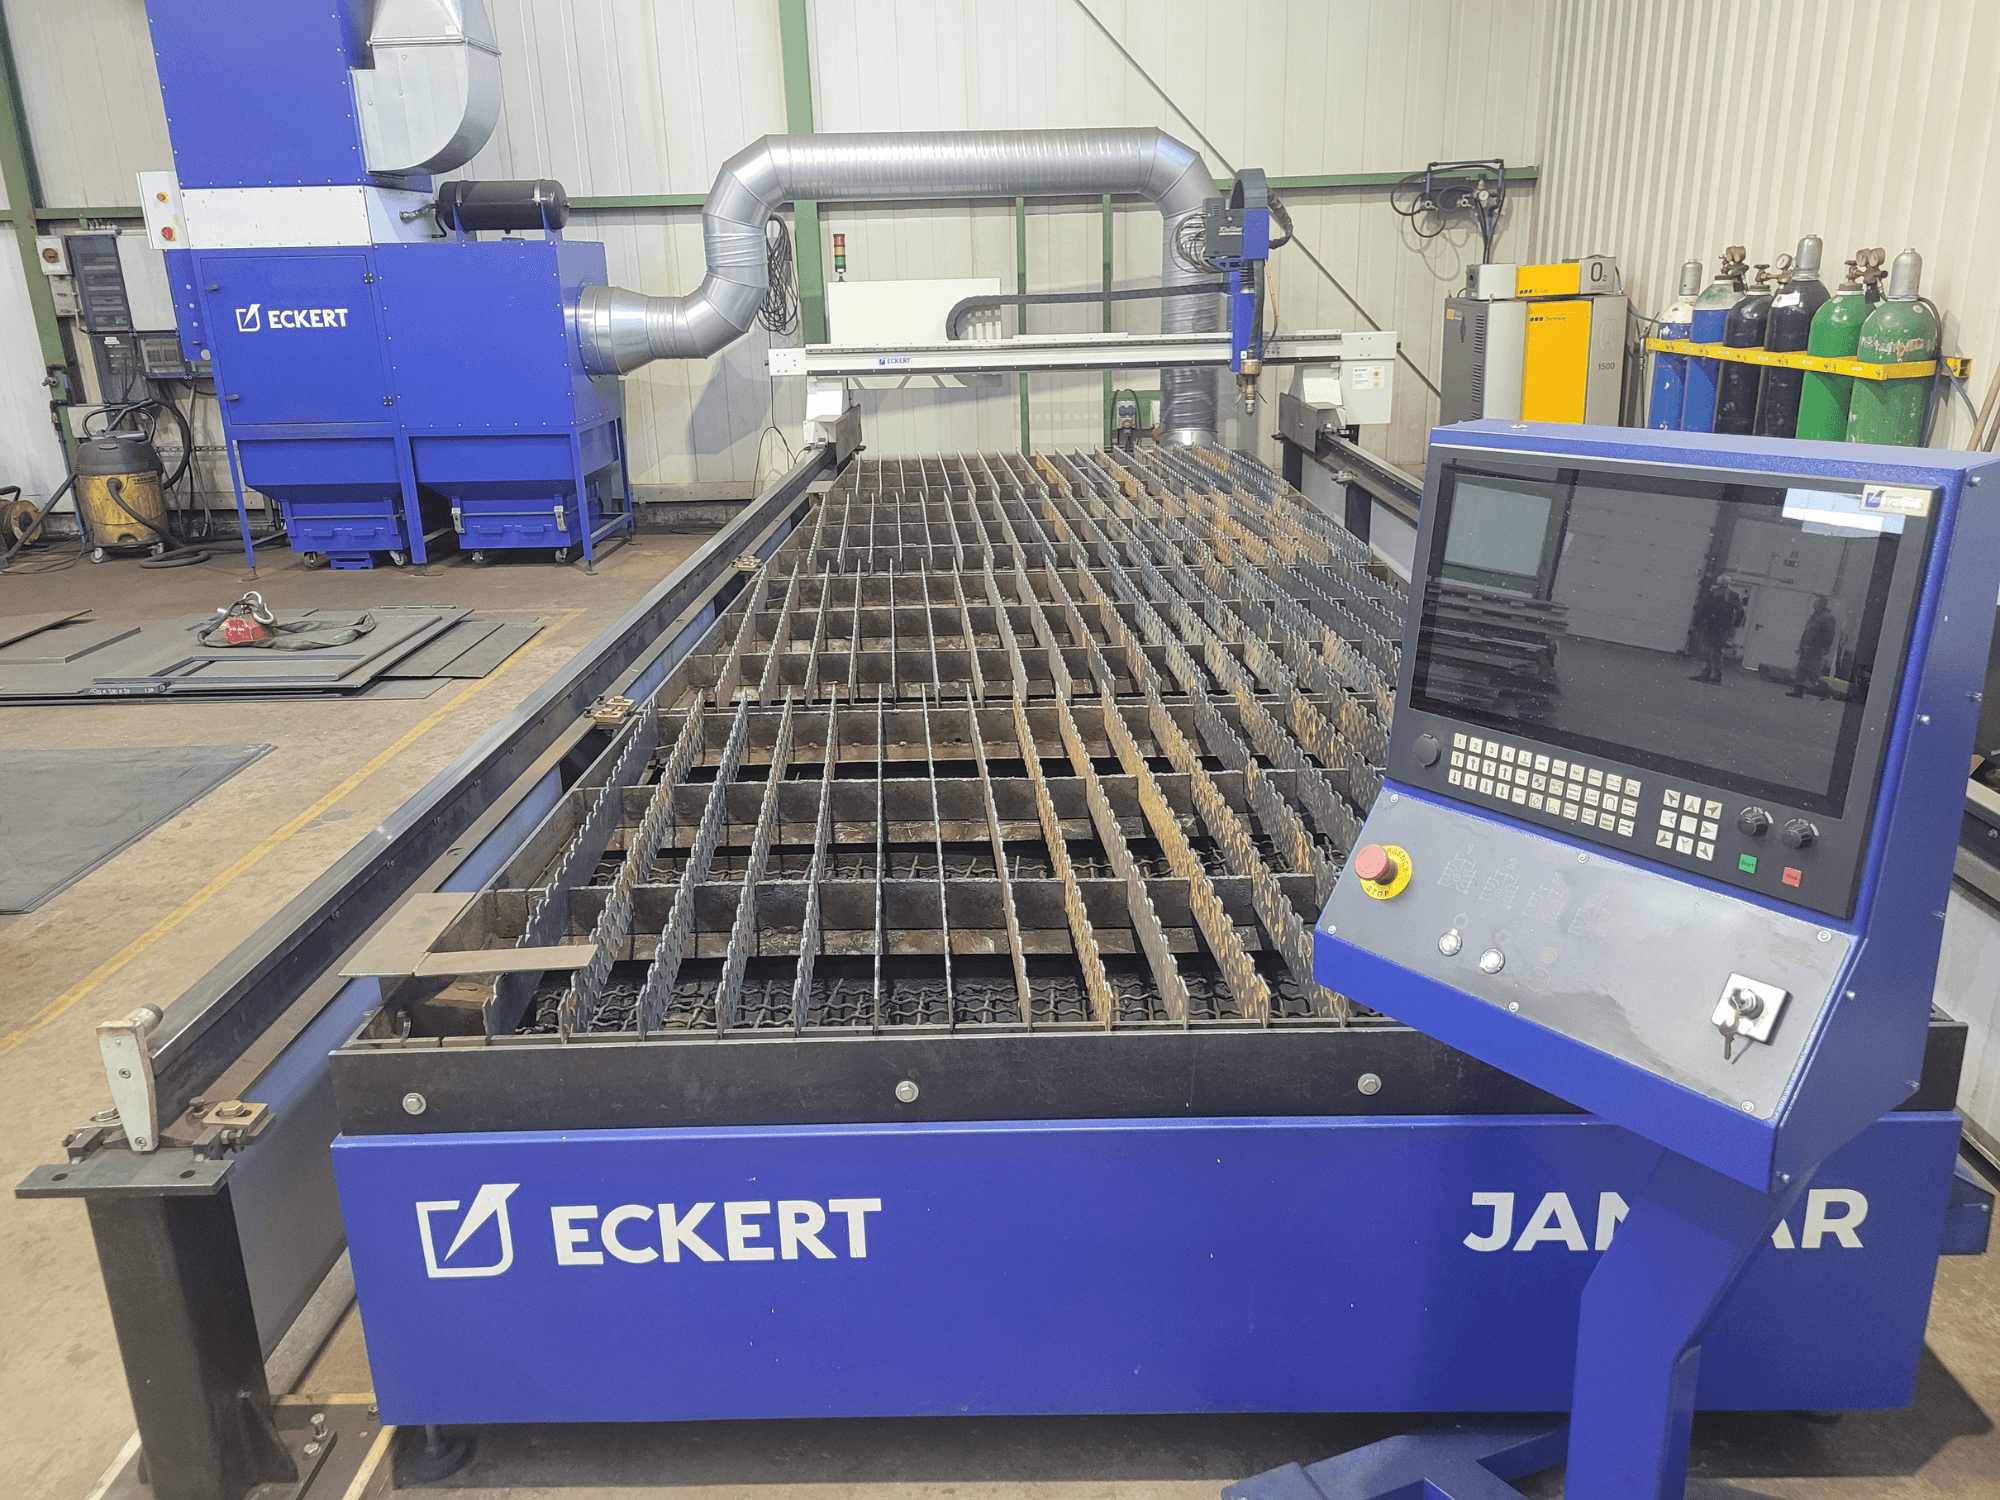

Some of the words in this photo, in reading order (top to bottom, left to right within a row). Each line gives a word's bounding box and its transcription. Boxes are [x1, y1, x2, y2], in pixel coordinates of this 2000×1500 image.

[268, 308, 348, 328] ECKERT
[1367, 885, 1388, 897] STOP
[551, 1198, 882, 1266] ECKERT
